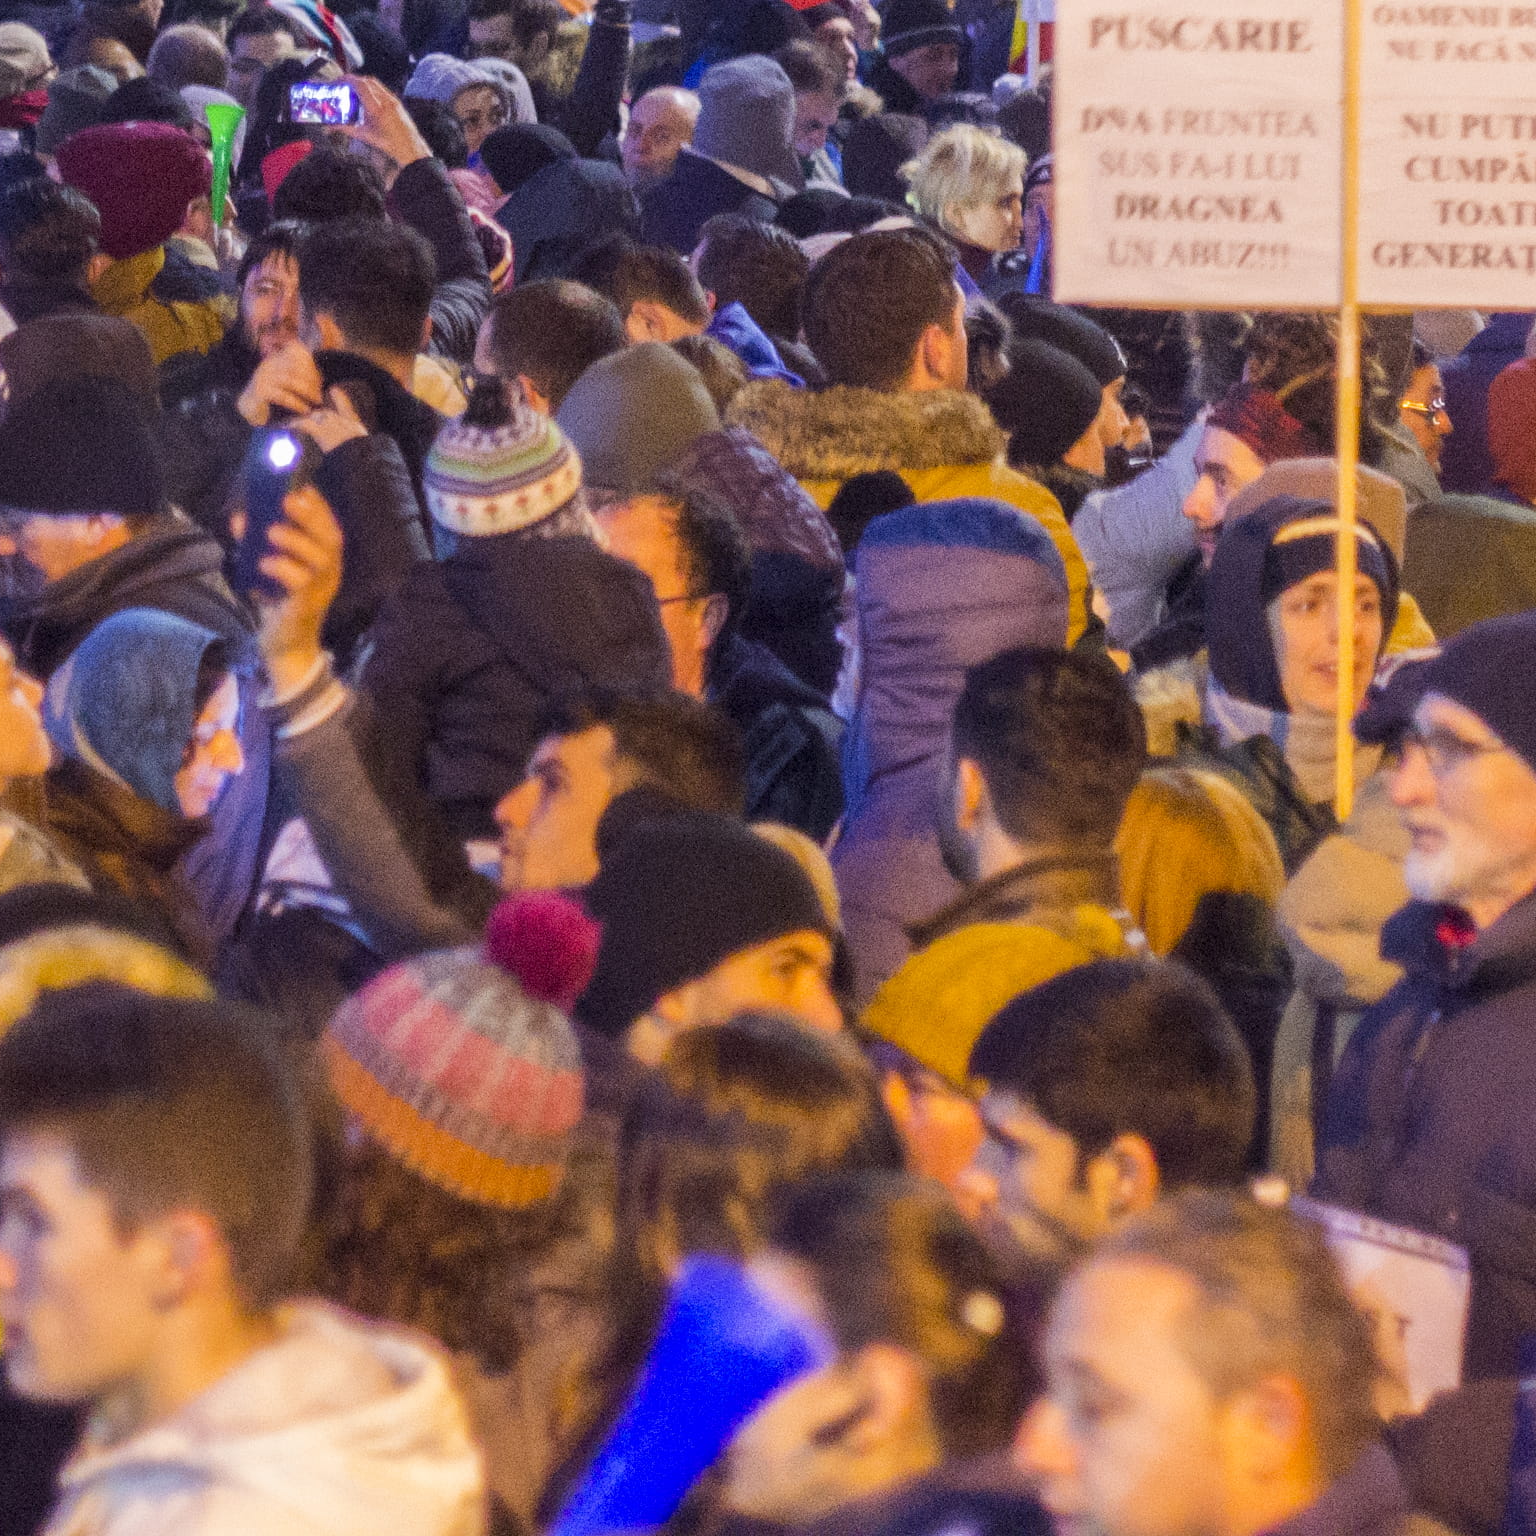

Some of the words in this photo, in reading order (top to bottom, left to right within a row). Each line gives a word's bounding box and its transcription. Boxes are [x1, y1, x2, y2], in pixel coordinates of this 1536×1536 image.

[1087, 15, 1313, 53] PUSCARIE
[1079, 106, 1153, 135] DNA
[1163, 109, 1319, 138] FRUNTEA
[1401, 112, 1447, 140] NU
[1114, 190, 1284, 224] DRAGNEA
